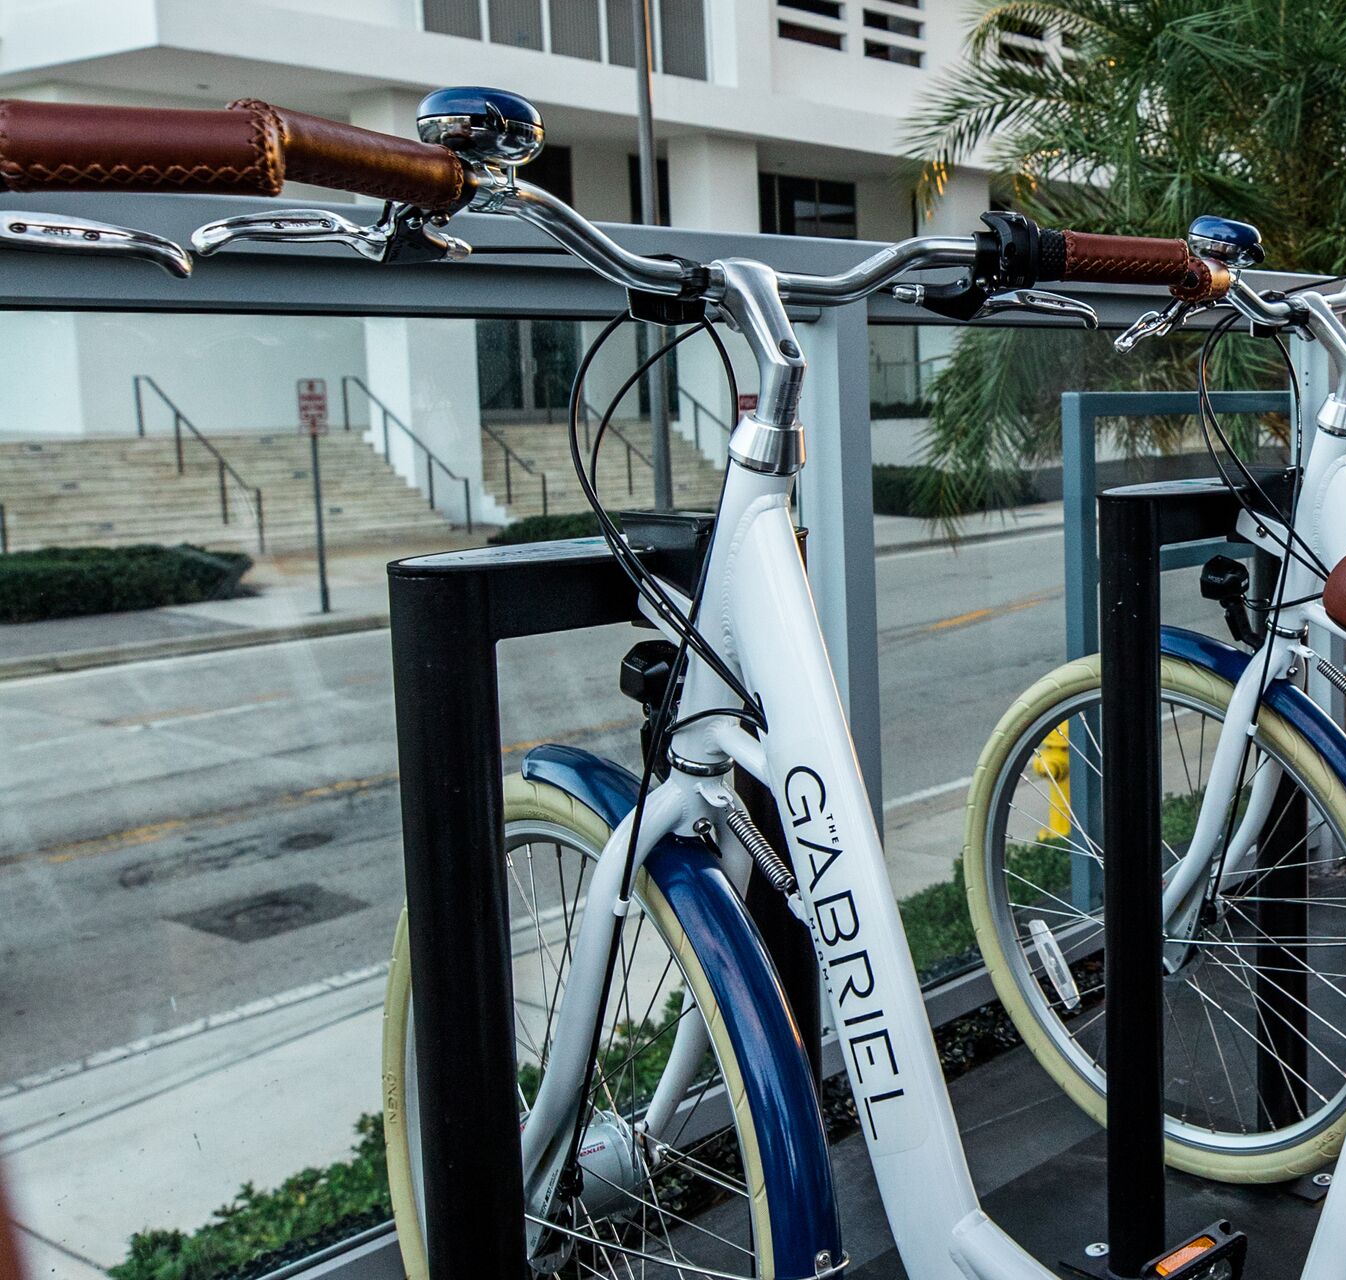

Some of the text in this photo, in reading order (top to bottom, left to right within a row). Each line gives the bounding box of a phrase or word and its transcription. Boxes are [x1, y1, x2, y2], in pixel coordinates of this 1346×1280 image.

[825, 813, 840, 845] THE
[784, 765, 905, 1141] GABRIEL
[807, 916, 834, 995] MIAMI
